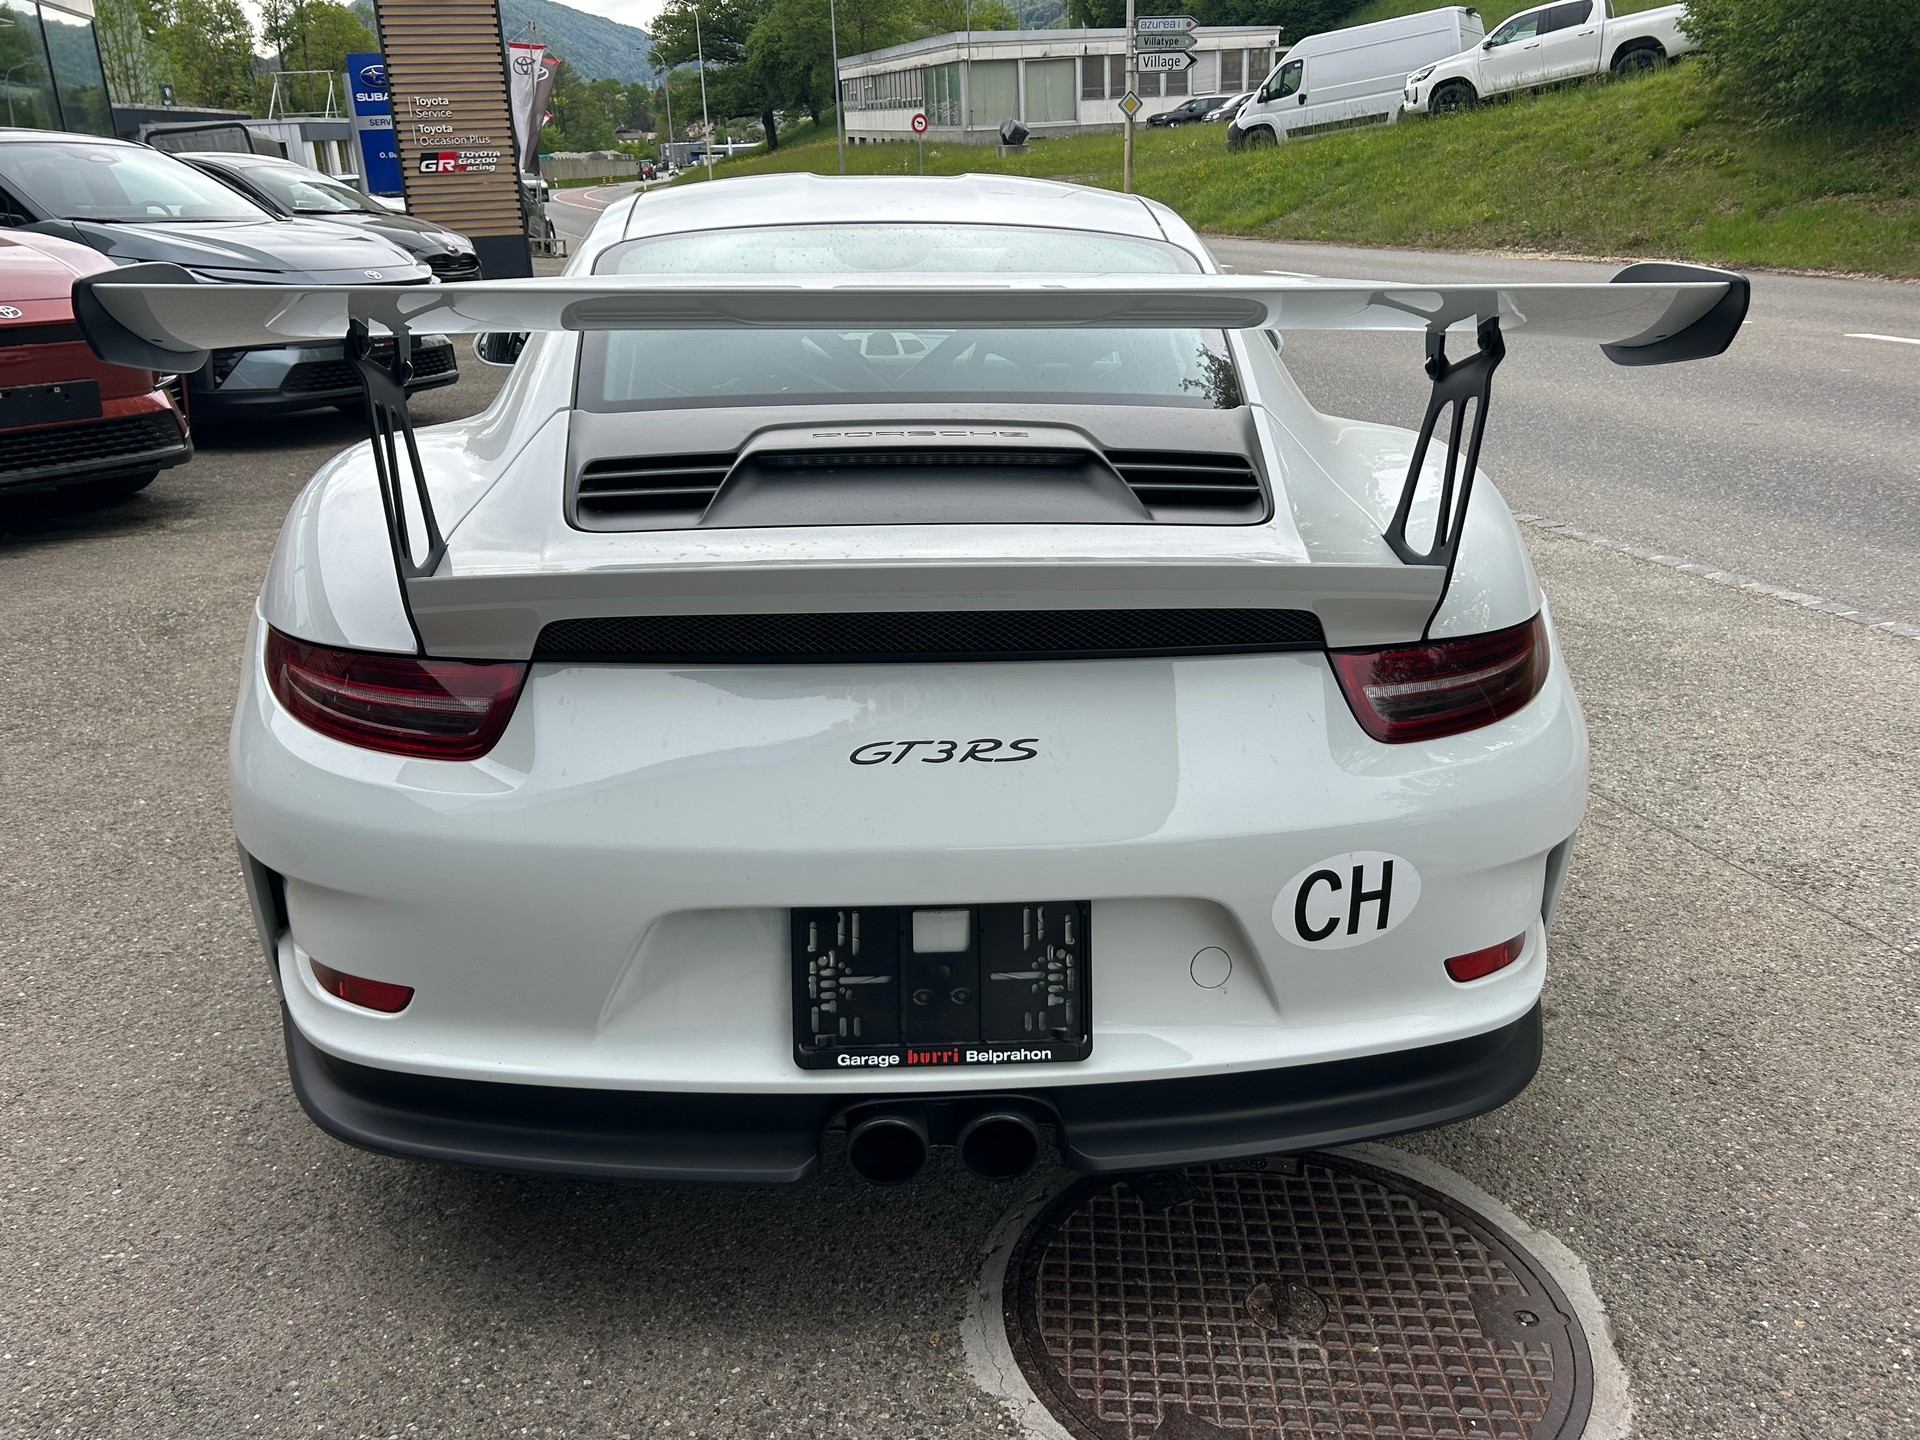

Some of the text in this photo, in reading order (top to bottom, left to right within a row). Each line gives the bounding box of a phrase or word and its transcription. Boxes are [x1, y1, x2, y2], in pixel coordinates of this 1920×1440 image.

[1143, 37, 1179, 47] Villatype
[1142, 55, 1181, 70] Village
[413, 96, 449, 107] Toyota
[415, 108, 453, 118] Service
[418, 124, 453, 135] Toyota
[420, 135, 491, 146] Occasion Plus
[420, 159, 456, 172] GR
[458, 157, 497, 165] GAZOO
[458, 164, 496, 172] Racing
[1294, 859, 1394, 942] CH
[837, 1048, 1052, 1067] Garage burri Belprahon
